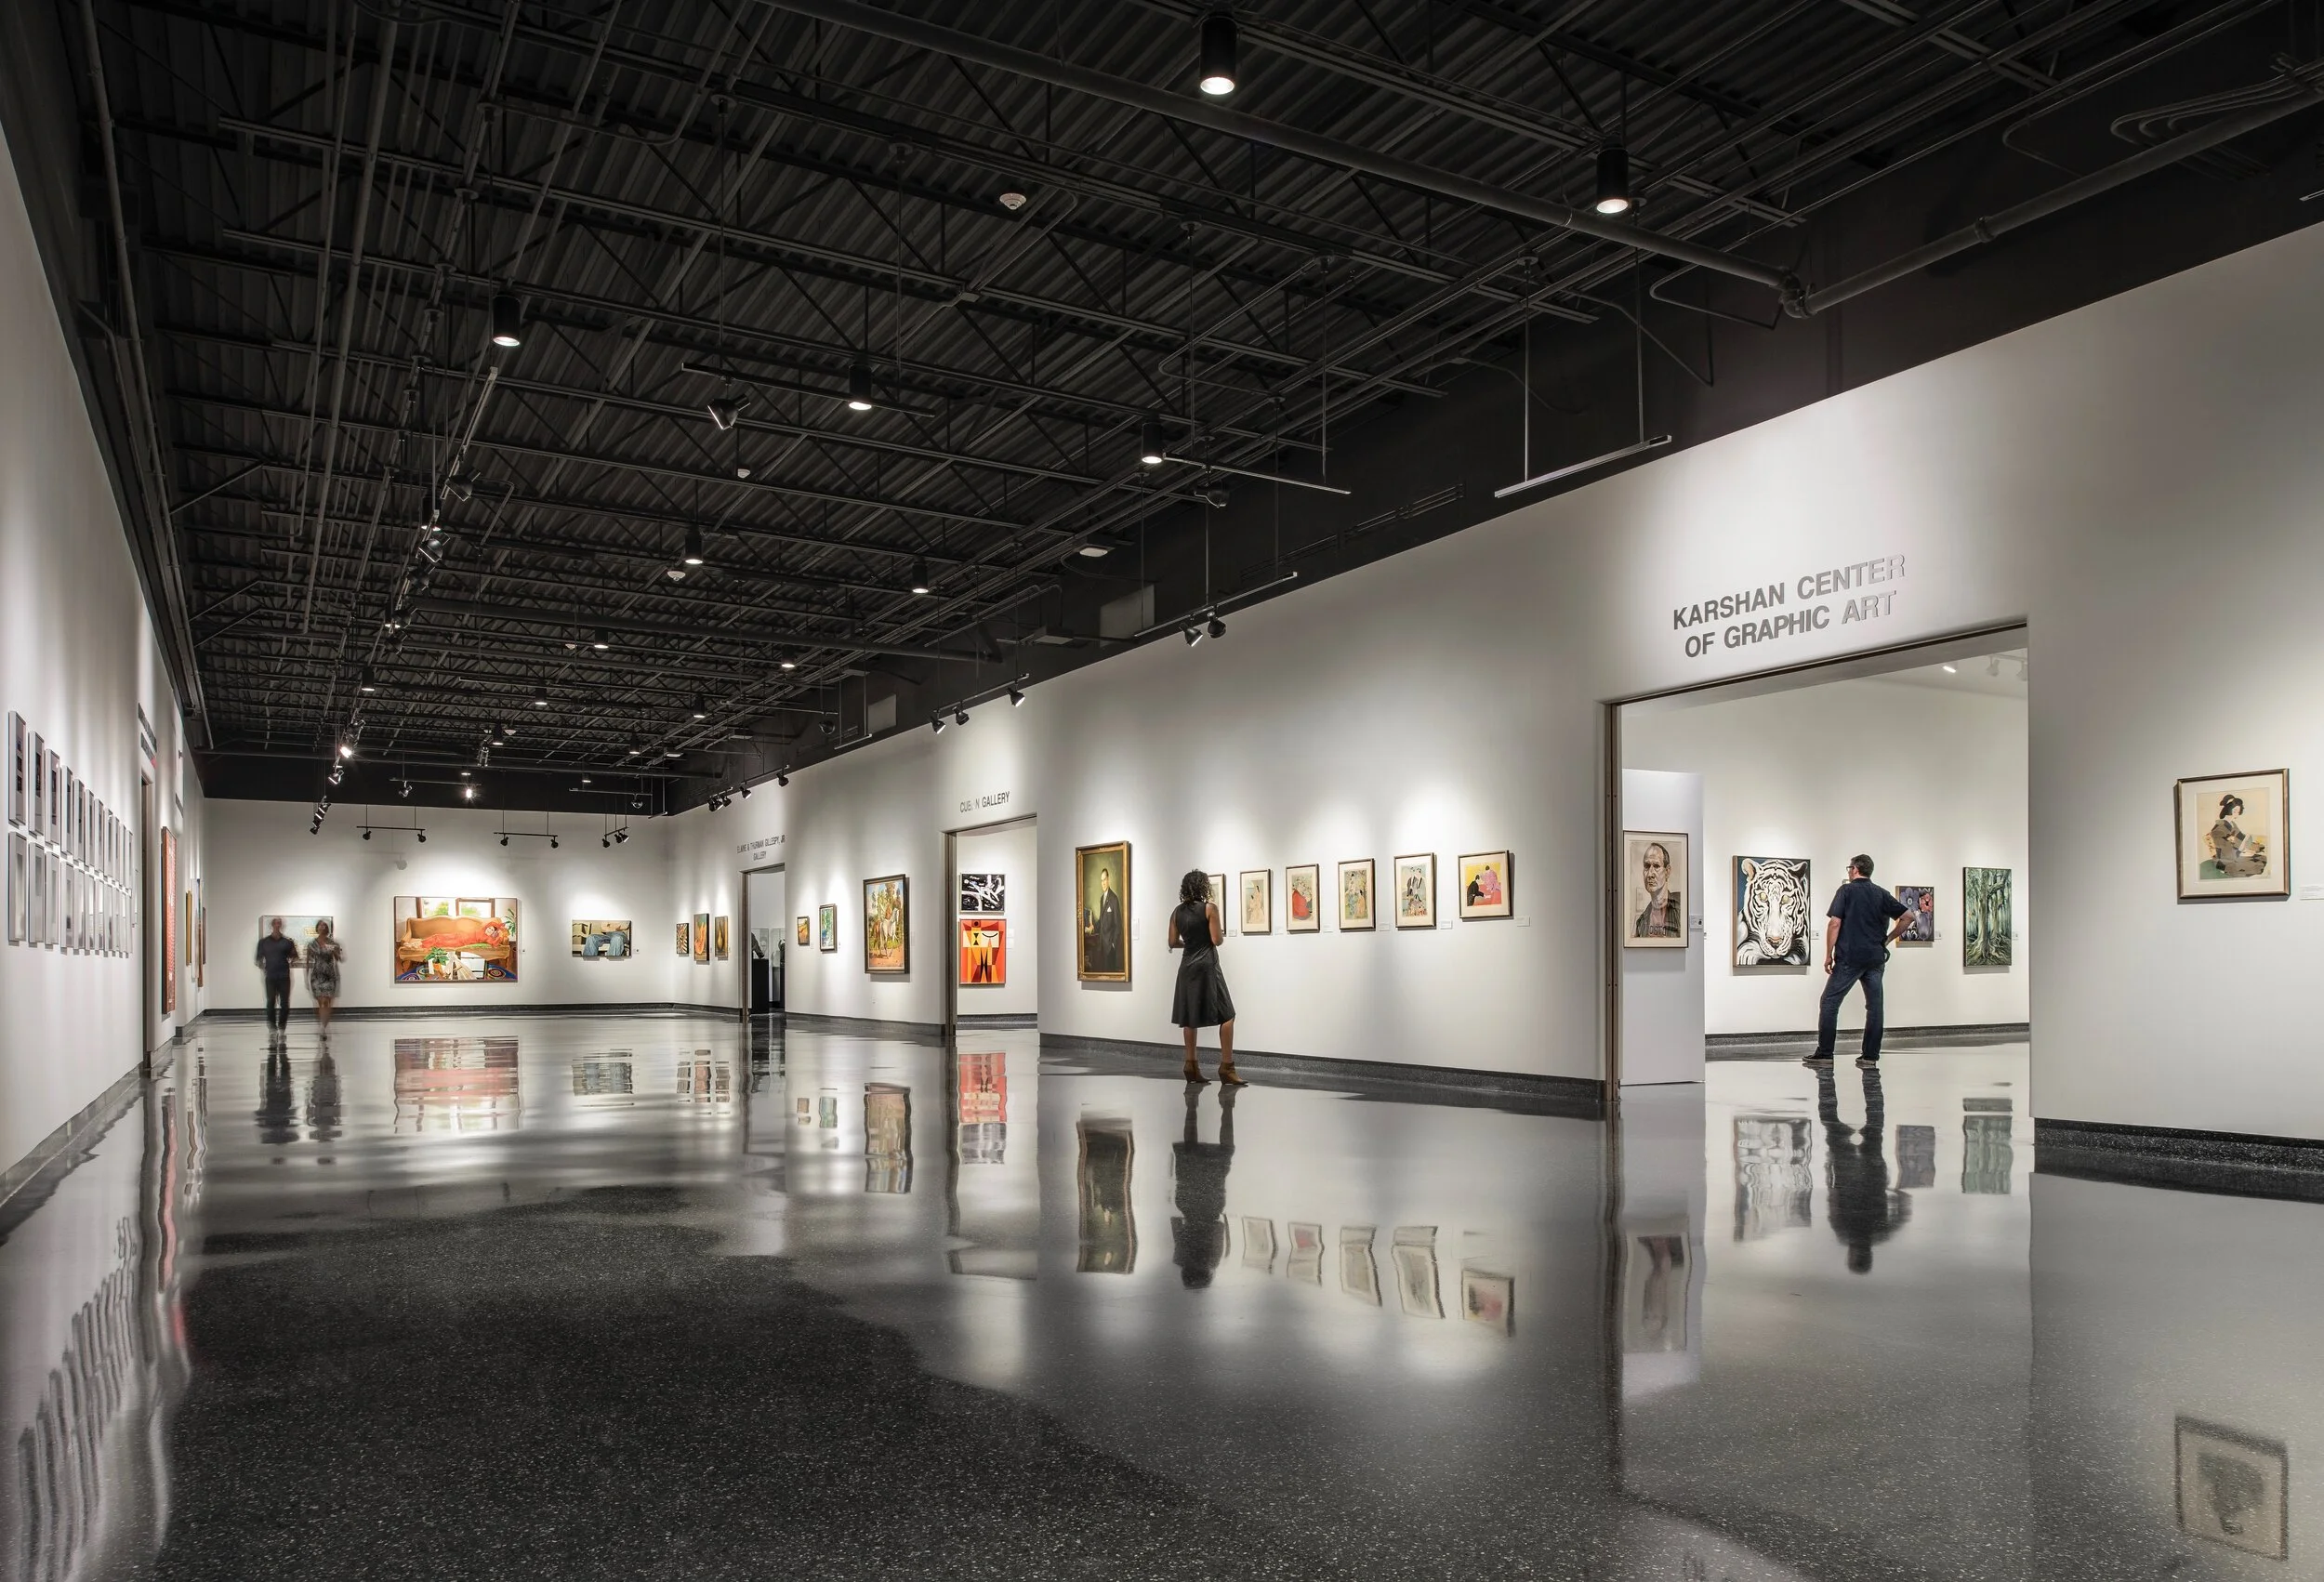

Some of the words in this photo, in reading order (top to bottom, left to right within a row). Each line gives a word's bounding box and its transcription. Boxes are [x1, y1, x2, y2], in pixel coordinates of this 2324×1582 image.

[1673, 582, 1785, 630] KARSHAN
[1797, 554, 1906, 600] CENTER
[1684, 632, 1715, 657] OF
[1723, 605, 1829, 648] GRAPHIC
[1841, 590, 1896, 625] ART
[959, 798, 980, 812] CUBN
[982, 791, 1010, 808] GALLERY
